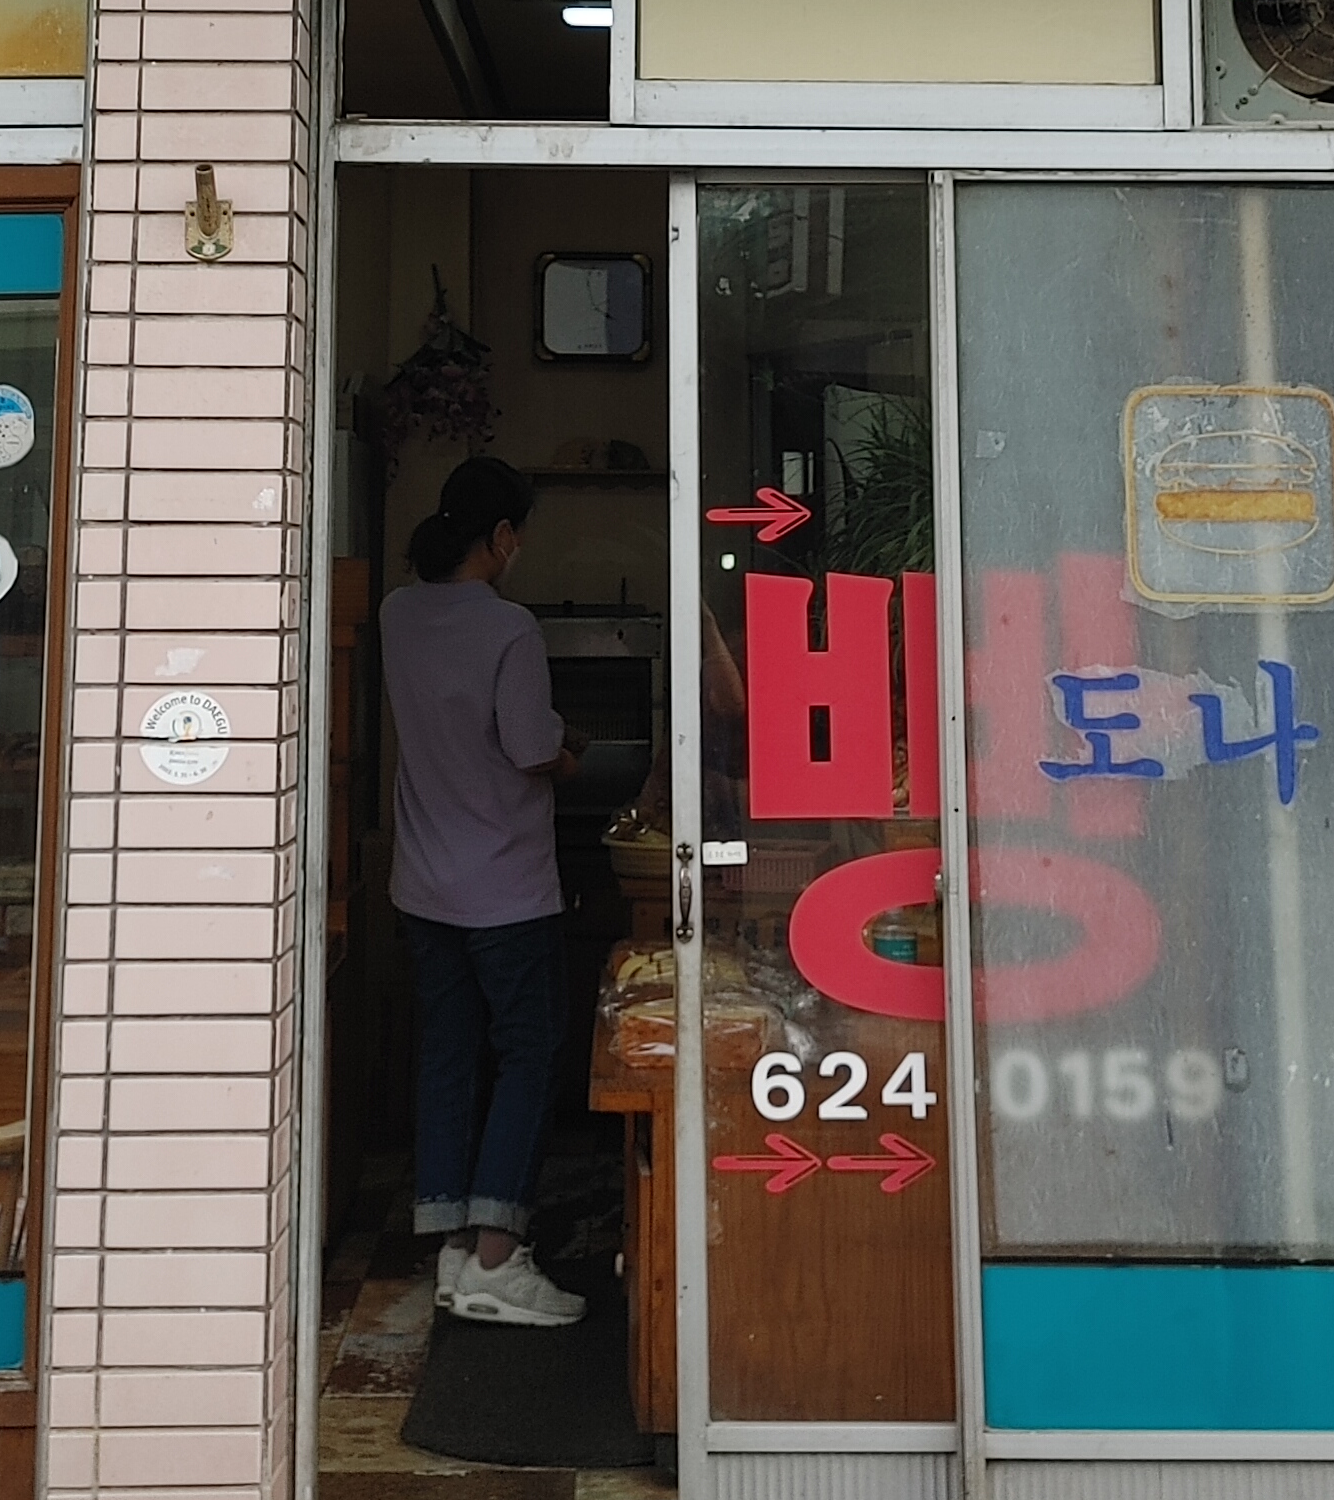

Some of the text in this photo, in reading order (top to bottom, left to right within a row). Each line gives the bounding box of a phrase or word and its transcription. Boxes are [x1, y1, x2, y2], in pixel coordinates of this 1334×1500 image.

[145, 694, 228, 735] Welcome to DAEGU
[750, 1047, 1223, 1122] 624 0159
